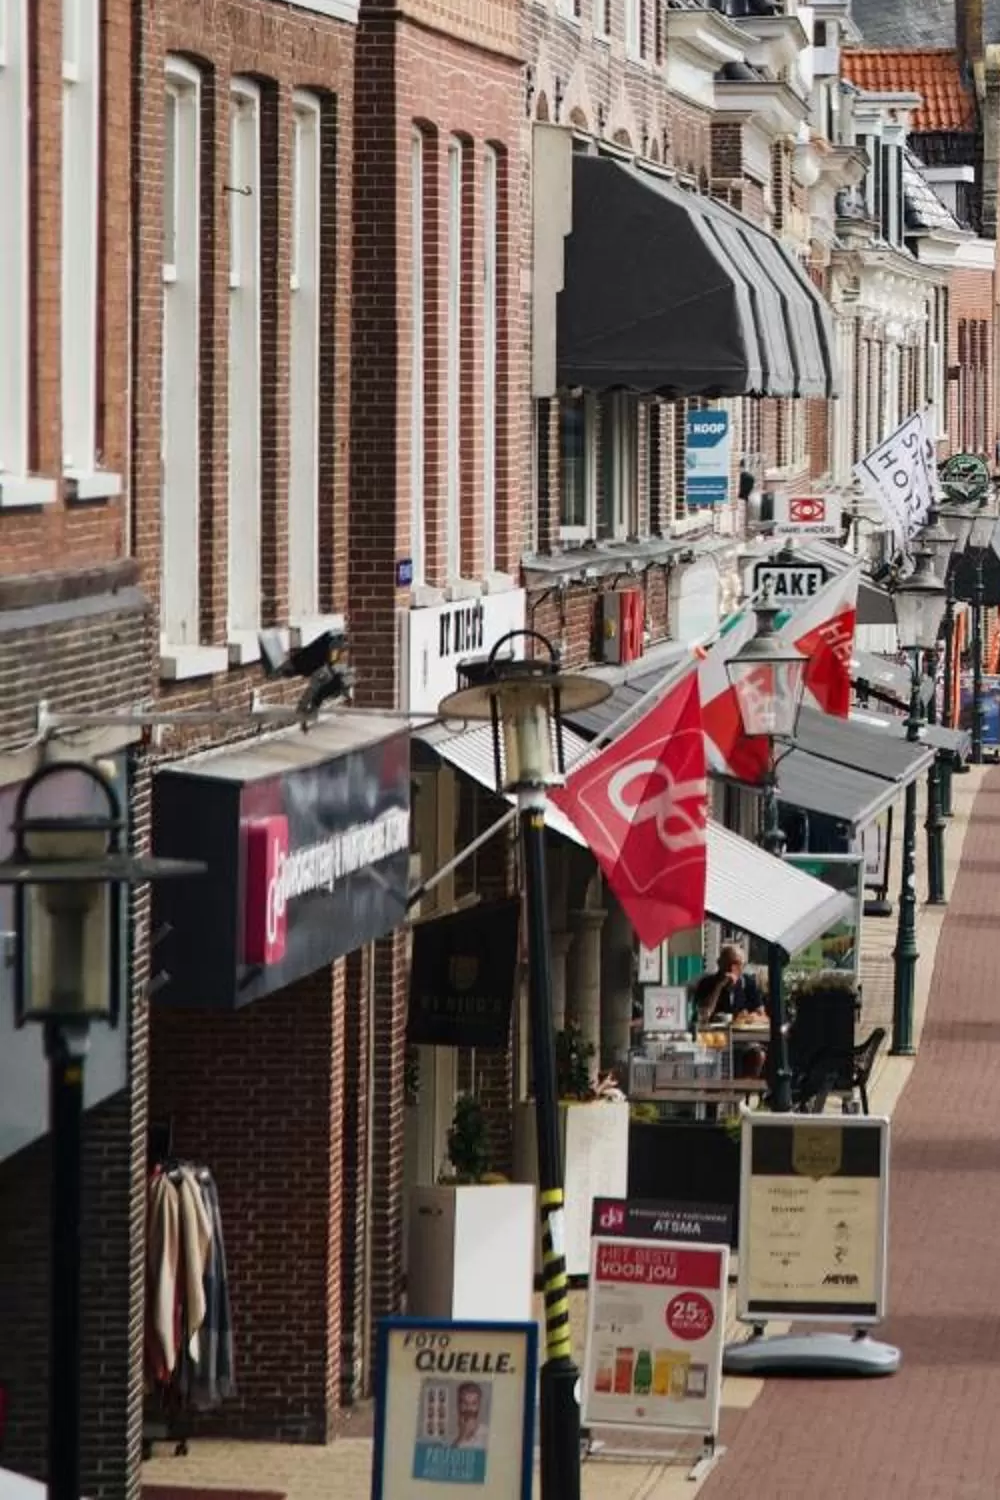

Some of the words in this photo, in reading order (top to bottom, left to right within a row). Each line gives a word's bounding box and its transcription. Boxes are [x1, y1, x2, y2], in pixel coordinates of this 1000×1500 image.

[652, 1219, 702, 1236] ATSMA
[600, 1260, 646, 1277] VOOR
[646, 1263, 677, 1282] JOU
[402, 1331, 452, 1350] FOTO
